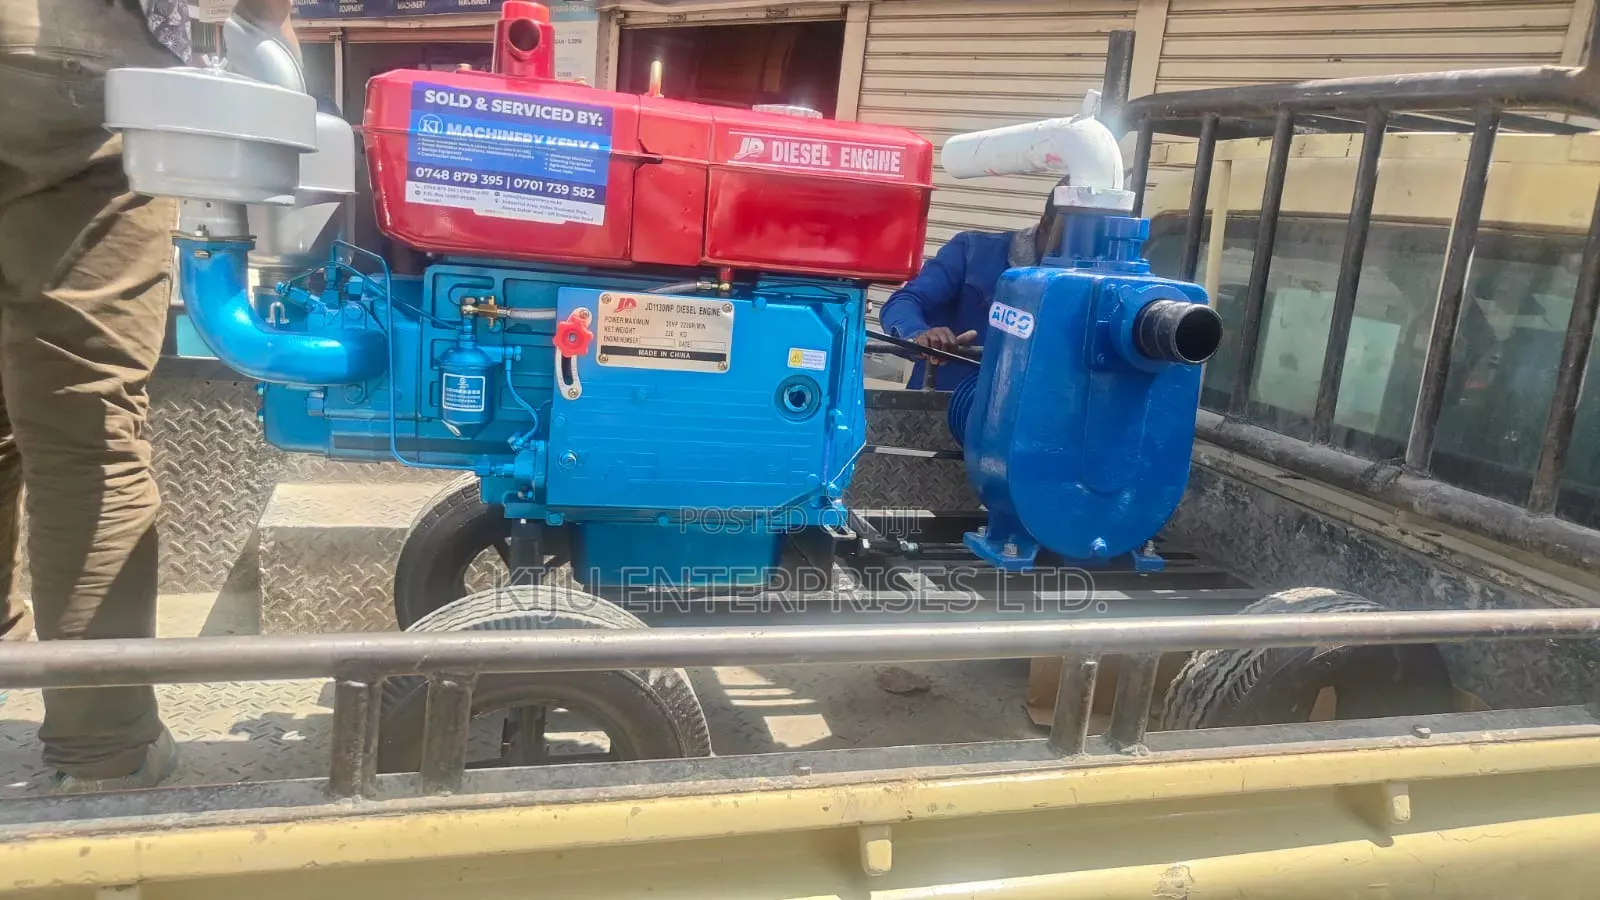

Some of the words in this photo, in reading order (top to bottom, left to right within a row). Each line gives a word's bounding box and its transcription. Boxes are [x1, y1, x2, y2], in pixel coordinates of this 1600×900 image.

[425, 90, 472, 109] SOLD
[475, 97, 488, 111] &
[491, 99, 574, 122] SERVICED
[577, 112, 603, 127] BY:
[771, 141, 831, 167] DIESEL
[840, 147, 901, 172] ENGINE
[415, 167, 450, 180] 0748
[453, 171, 478, 183] 879
[480, 174, 503, 186] 395
[514, 178, 543, 191] 0701
[546, 183, 569, 195] 739
[572, 187, 596, 199] 582
[676, 305, 696, 315] DIESEL
[699, 307, 720, 316] ENGINE
[638, 349, 658, 357] MADE
[670, 351, 691, 359] CHINA
